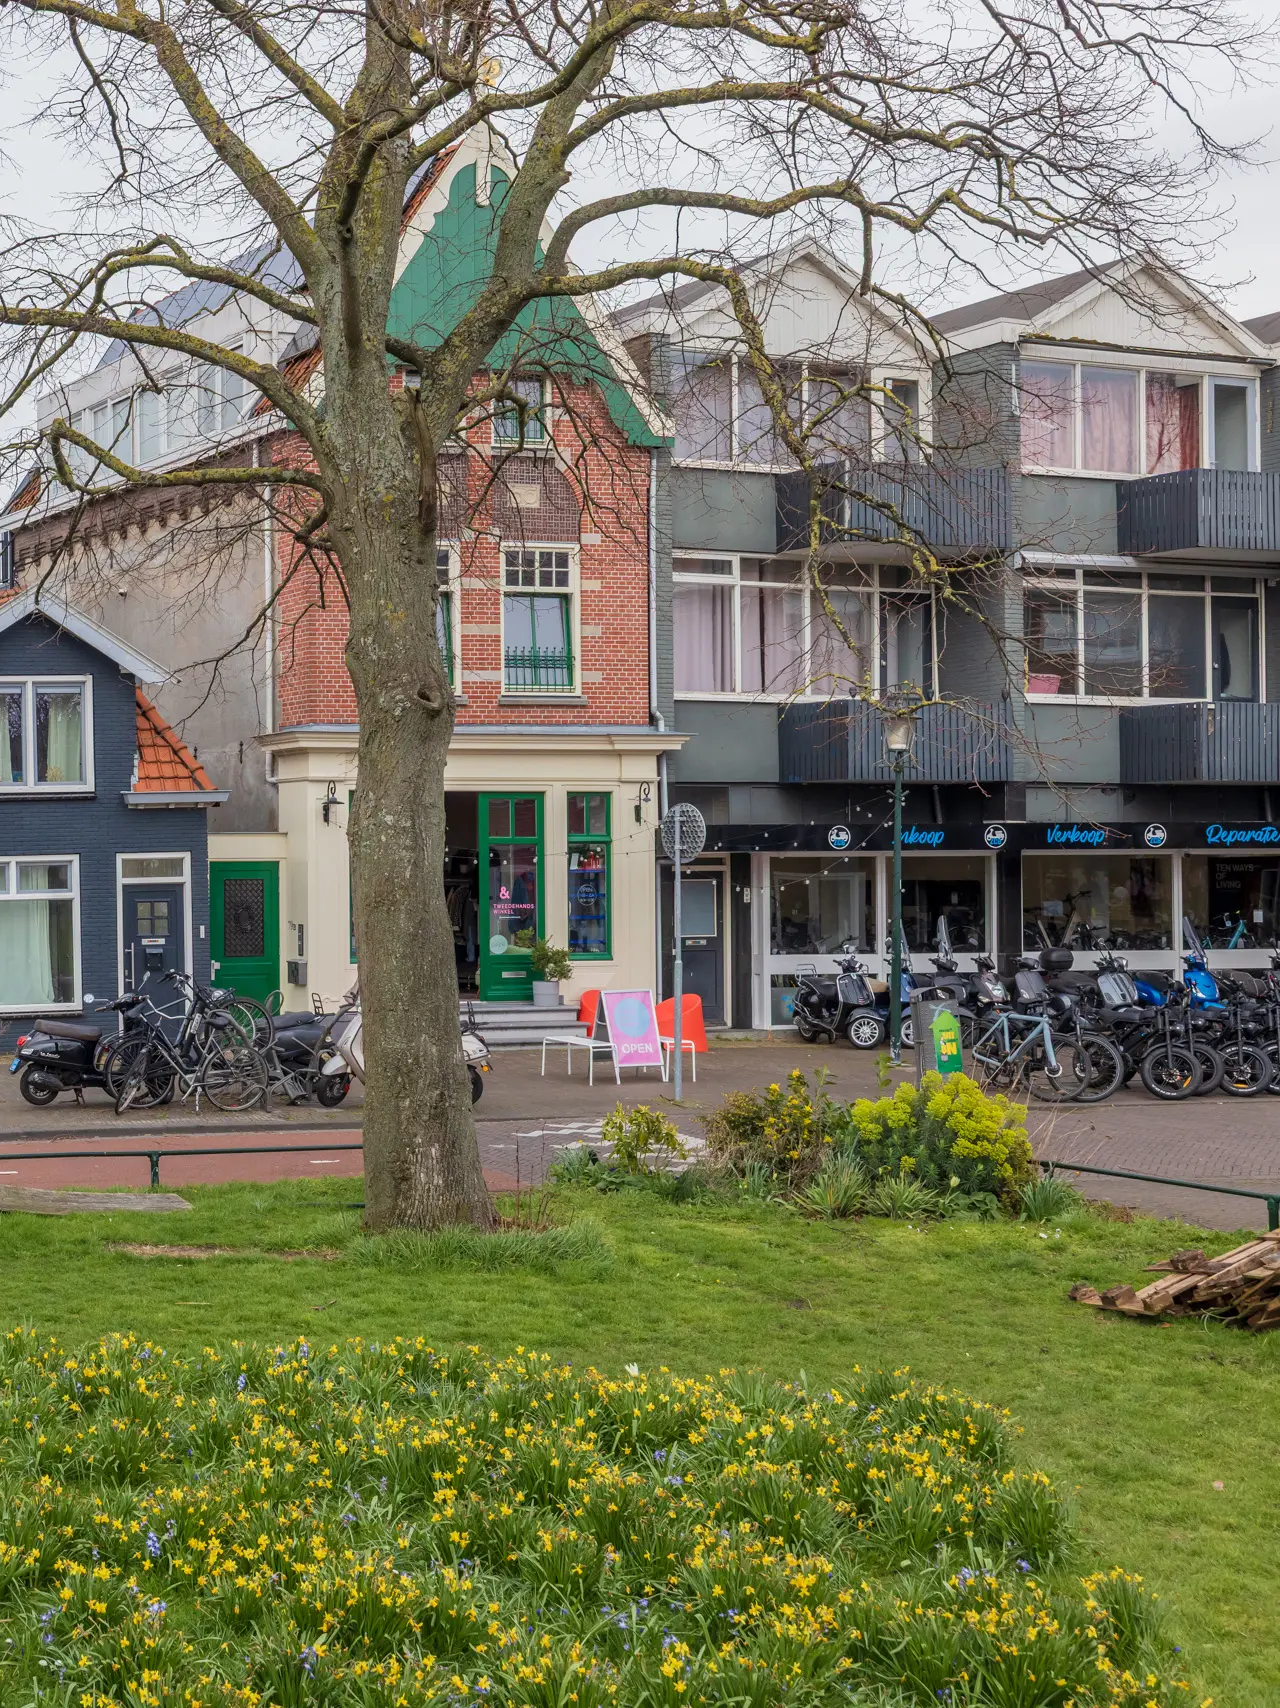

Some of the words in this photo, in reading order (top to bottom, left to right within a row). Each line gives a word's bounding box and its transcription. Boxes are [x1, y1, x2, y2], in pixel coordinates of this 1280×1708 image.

[892, 825, 945, 848] nkoop
[1047, 824, 1105, 847] Verkoop
[1215, 863, 1231, 872] TEN
[1232, 863, 1255, 872] WAYS
[1215, 872, 1227, 880] OF
[1215, 880, 1241, 889] LIVING
[499, 886, 510, 899] &
[621, 1043, 653, 1054] OPEN
